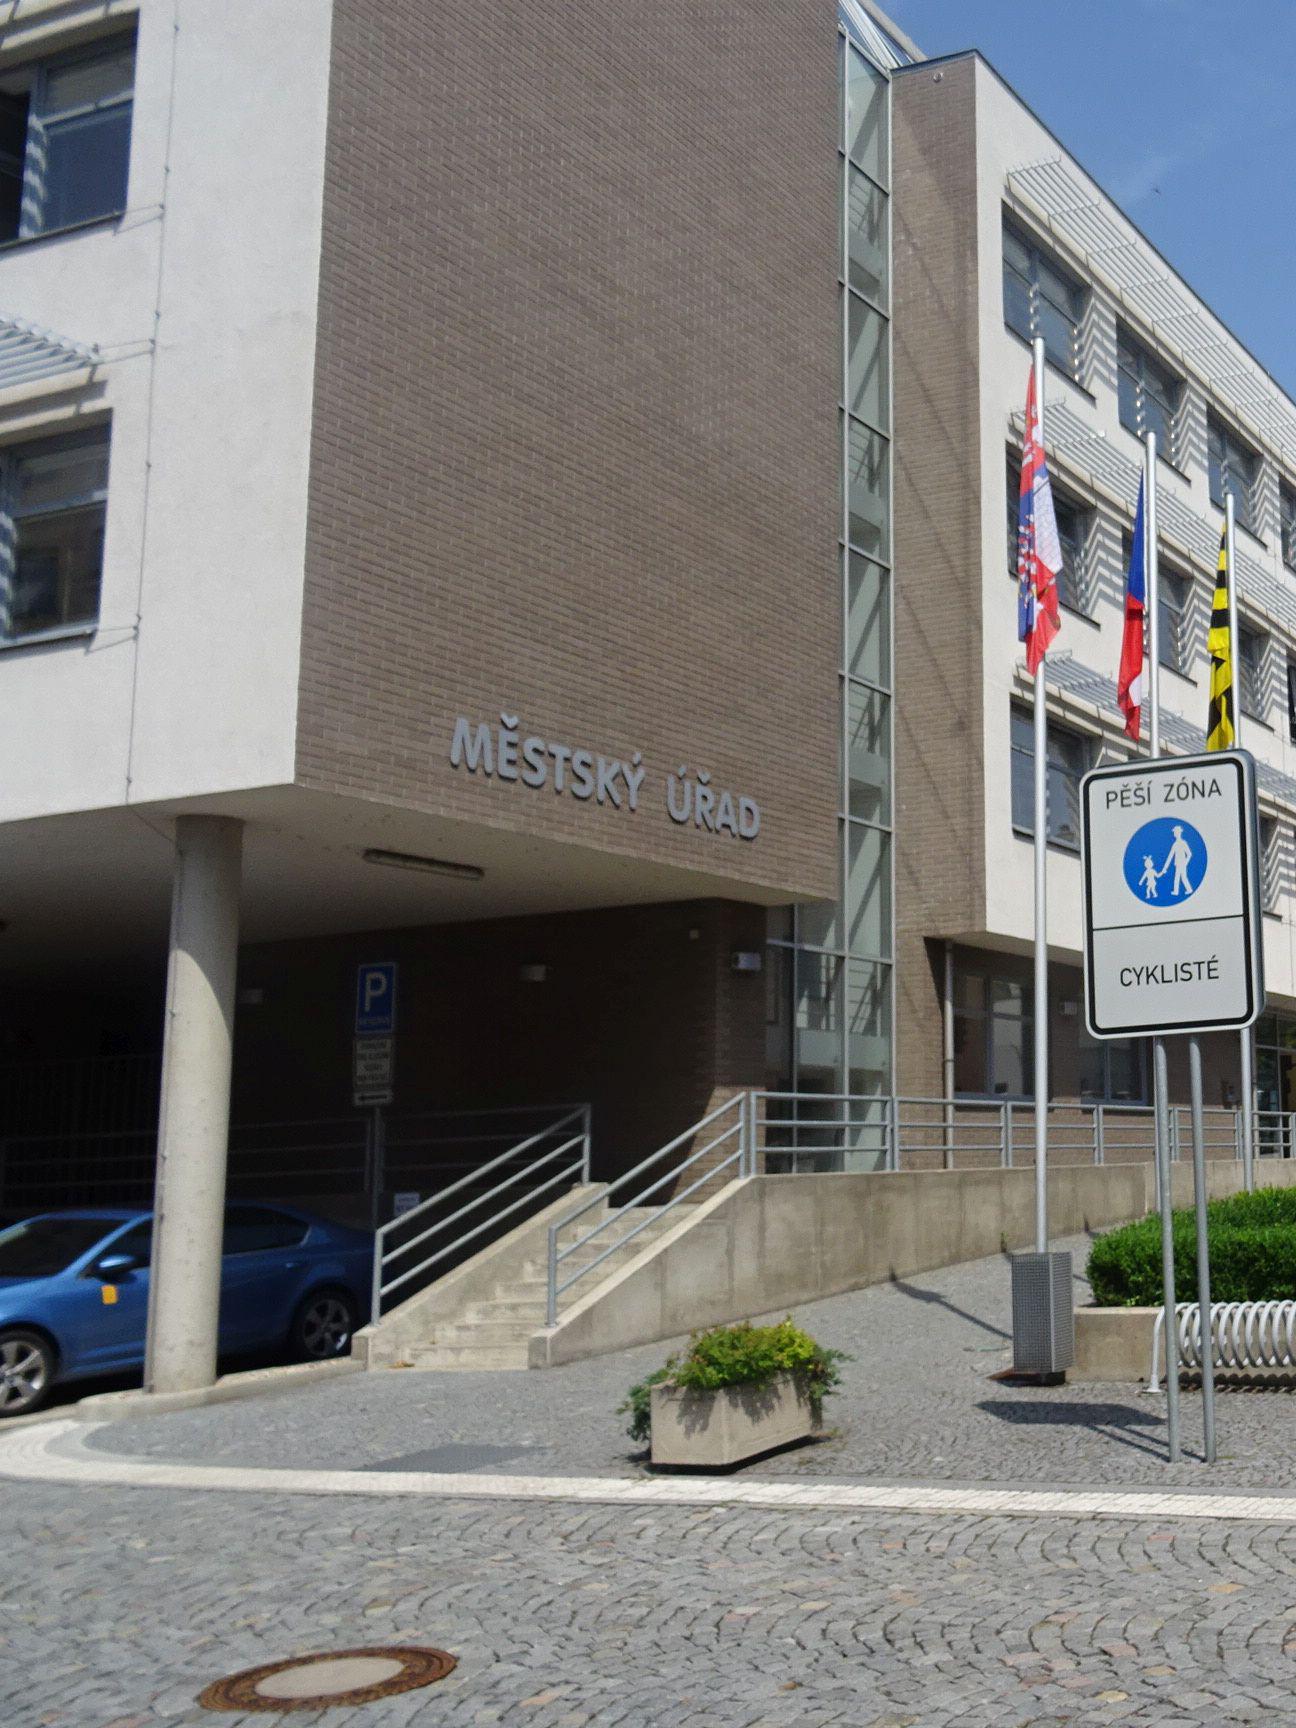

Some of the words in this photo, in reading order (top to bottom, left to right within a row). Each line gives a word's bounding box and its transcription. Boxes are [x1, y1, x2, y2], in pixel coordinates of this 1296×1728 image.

[450, 712, 645, 811] MĚSTSKÝ
[667, 765, 761, 840] ÚŘAD
[1106, 780, 1152, 809] PĚŠÍ
[1163, 776, 1222, 803] ZÓNA
[1120, 955, 1219, 987] CYKLISTÉ
[365, 971, 388, 1012] P
